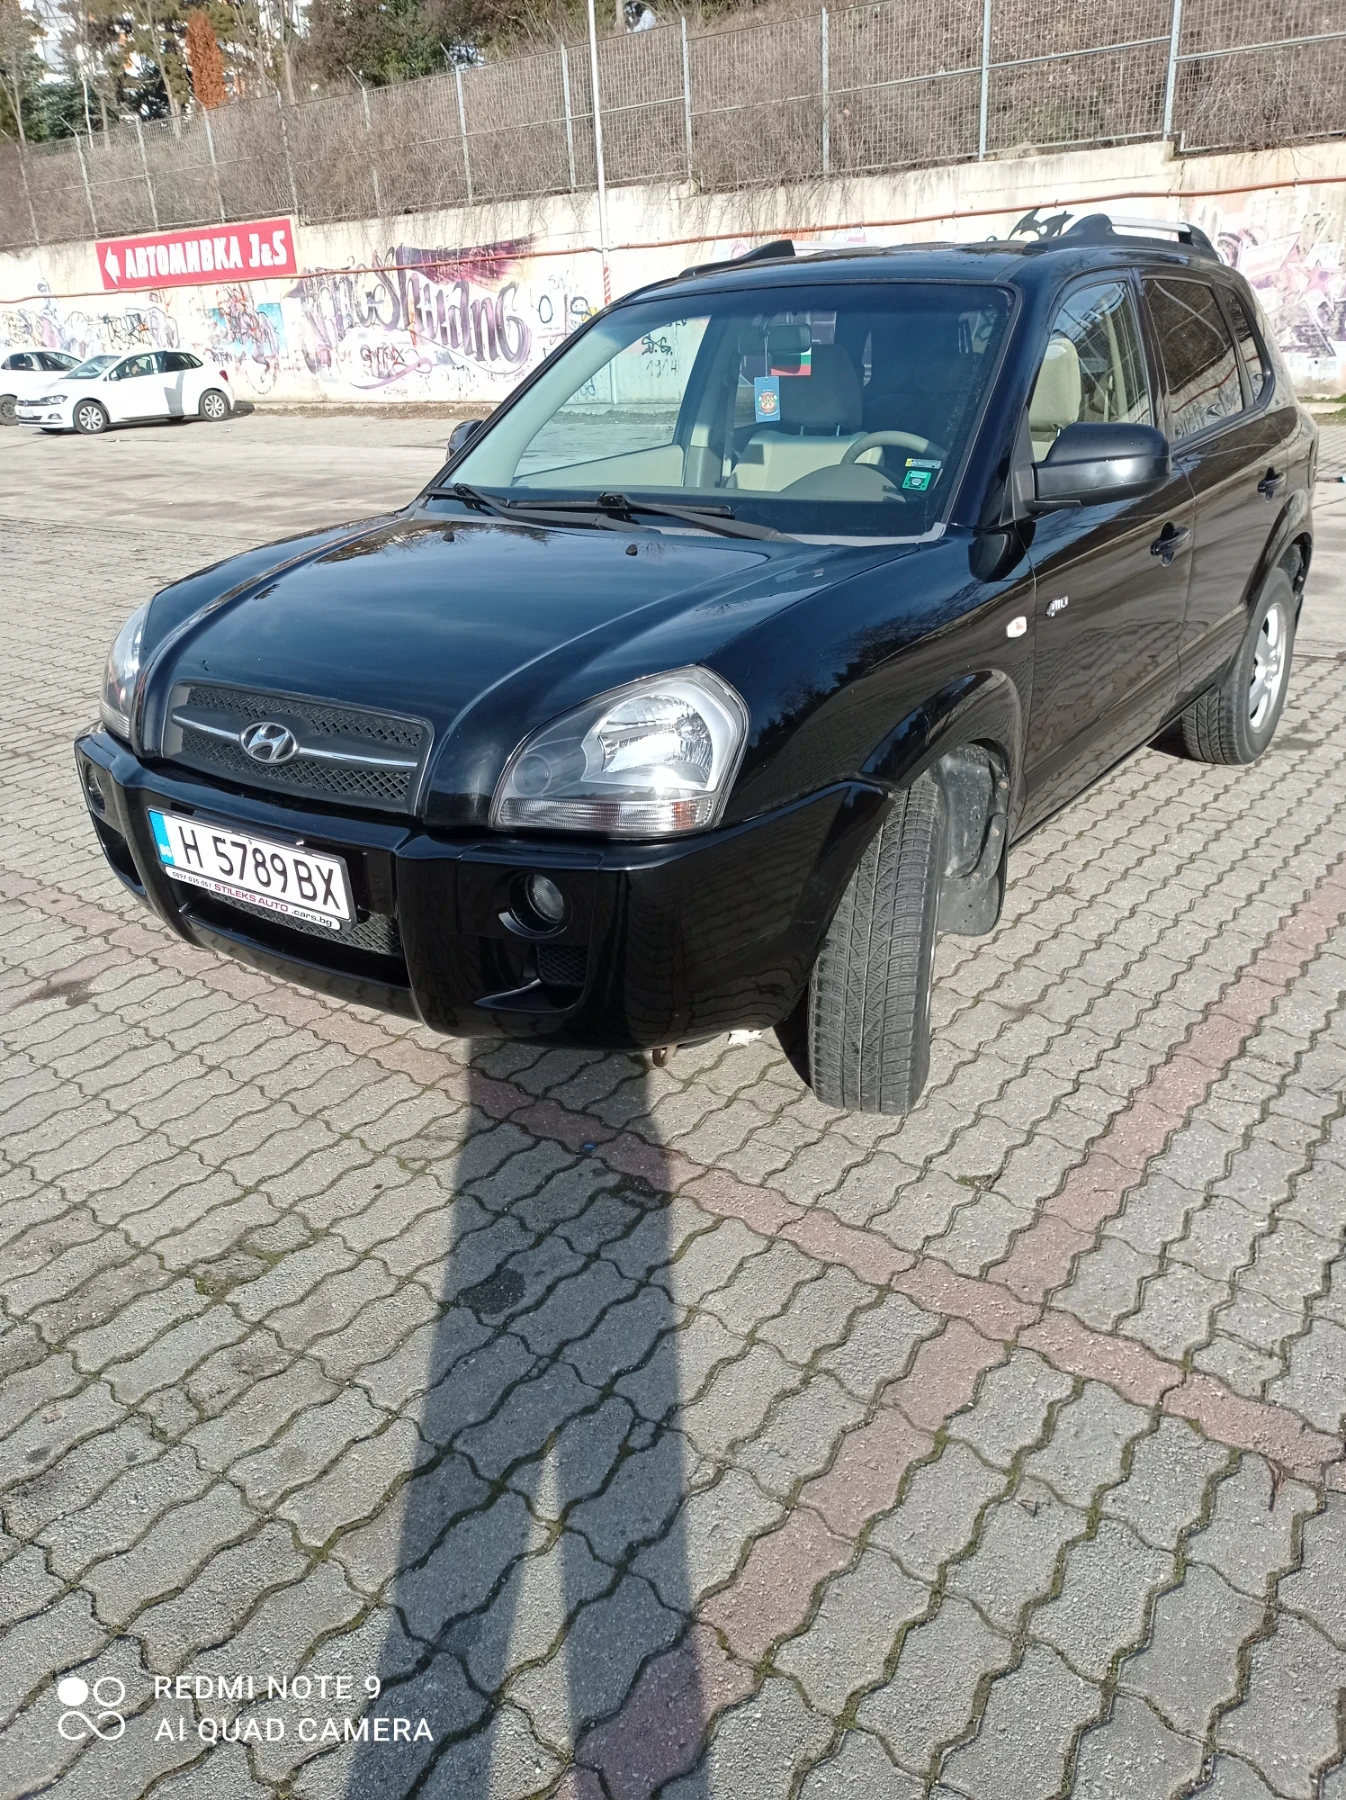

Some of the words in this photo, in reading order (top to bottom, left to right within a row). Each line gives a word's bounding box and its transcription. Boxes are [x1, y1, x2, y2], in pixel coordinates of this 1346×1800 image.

[125, 236, 244, 279] АВТОМИВКА
[248, 230, 287, 268] J&S
[178, 825, 203, 869] H
[212, 835, 288, 893] 5789
[293, 858, 341, 910] BX
[215, 883, 257, 902] STILEKS
[258, 897, 289, 912] AUTO
